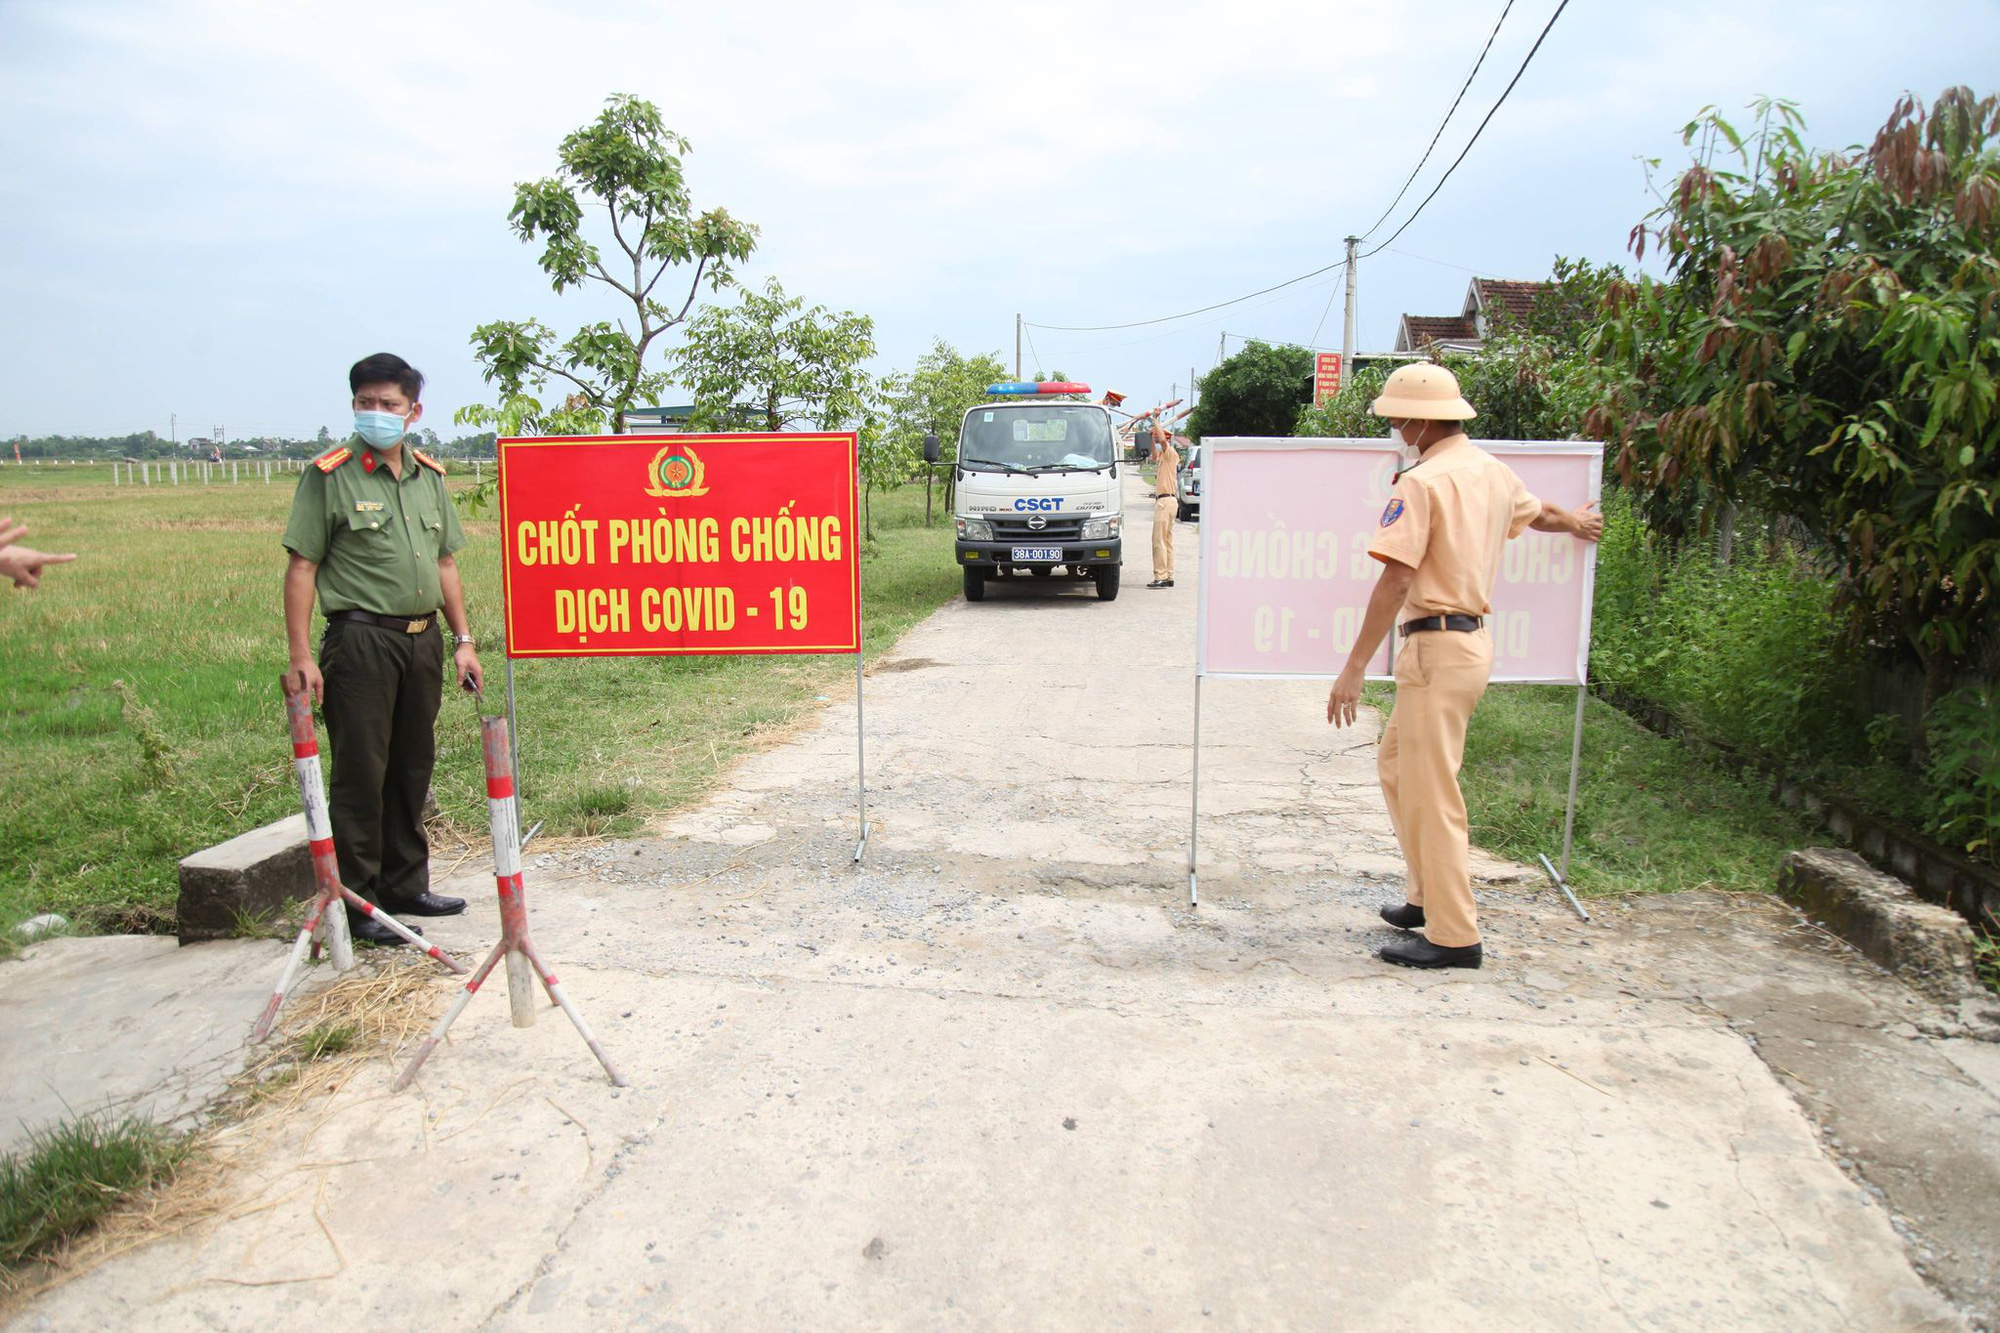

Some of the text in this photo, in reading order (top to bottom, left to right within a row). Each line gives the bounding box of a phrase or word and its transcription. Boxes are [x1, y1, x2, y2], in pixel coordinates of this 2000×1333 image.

[517, 500, 842, 566] CHỐT PHÒNG CHỐNG
[1014, 498, 1064, 511] CSGT
[555, 588, 631, 644] DỊCH
[640, 586, 736, 633] COVID
[769, 585, 808, 631] 19
